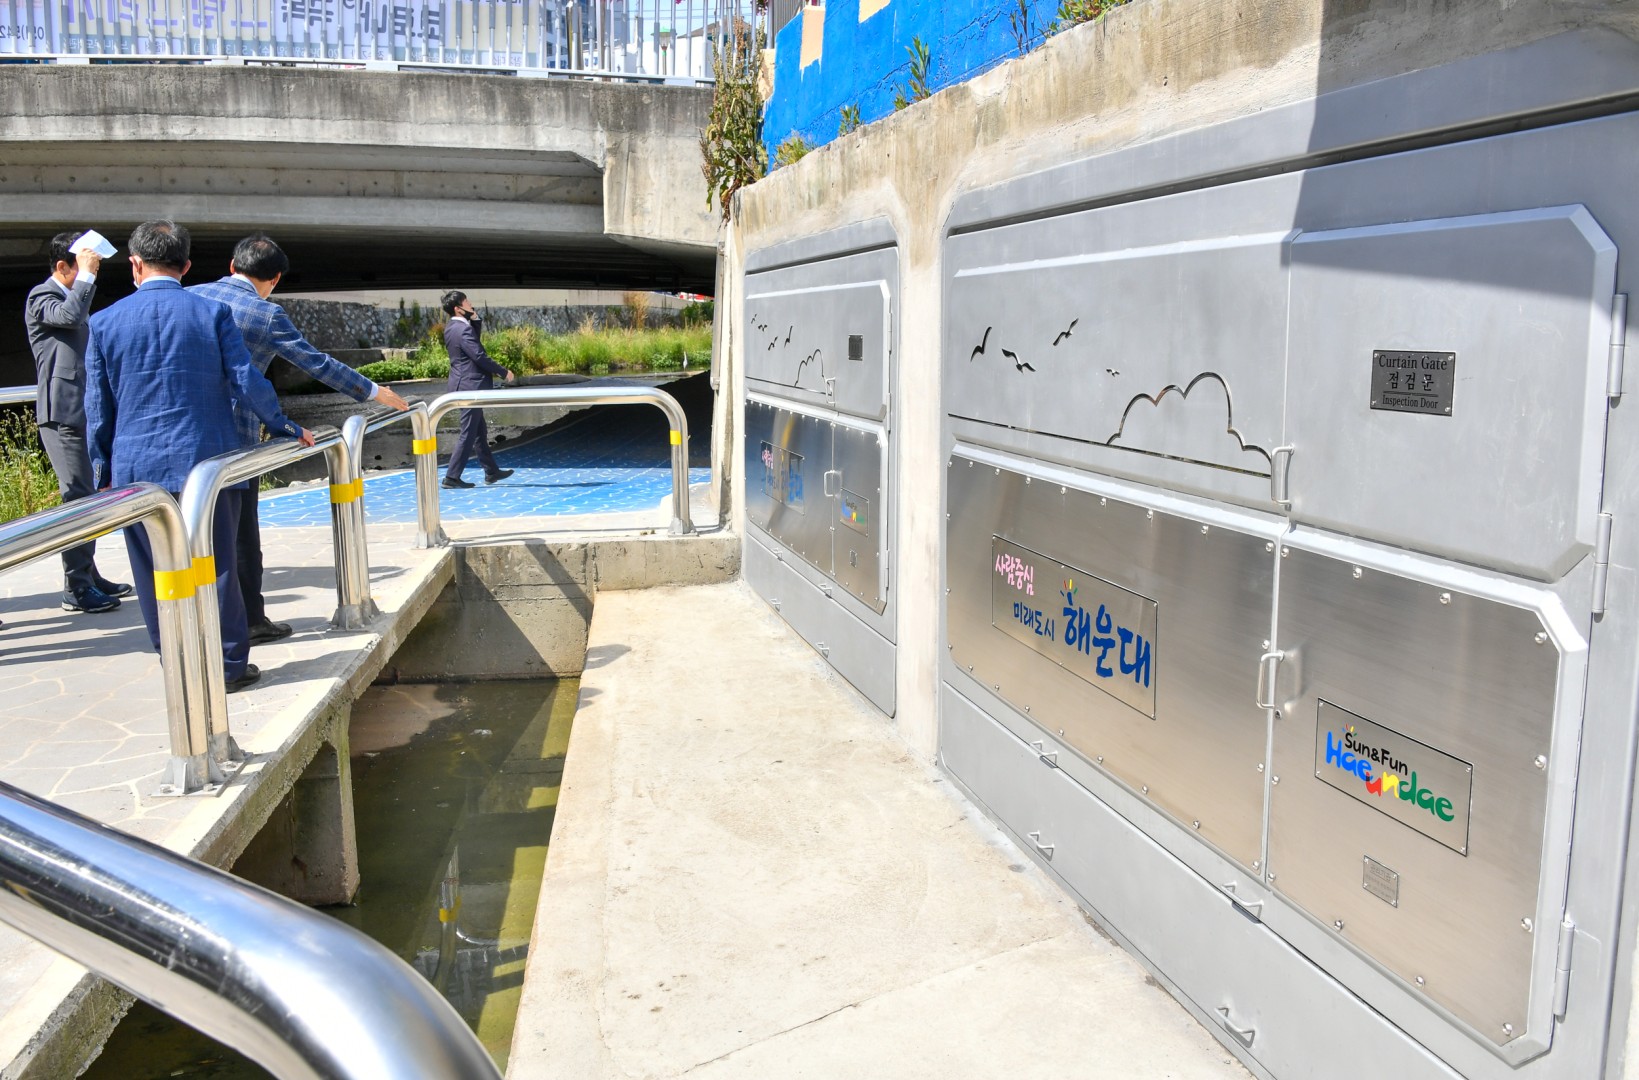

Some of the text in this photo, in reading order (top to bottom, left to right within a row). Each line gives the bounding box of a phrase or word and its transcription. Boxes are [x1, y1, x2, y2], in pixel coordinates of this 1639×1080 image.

[1379, 354, 1447, 370] Curtain Gate
[1382, 394, 1438, 409] Inspection Door
[995, 554, 1034, 595] 사람중심
[1013, 592, 1151, 688] 미래도시 해운대
[1345, 732, 1408, 776] Sun&Fun
[1326, 731, 1454, 822] Haeundae
